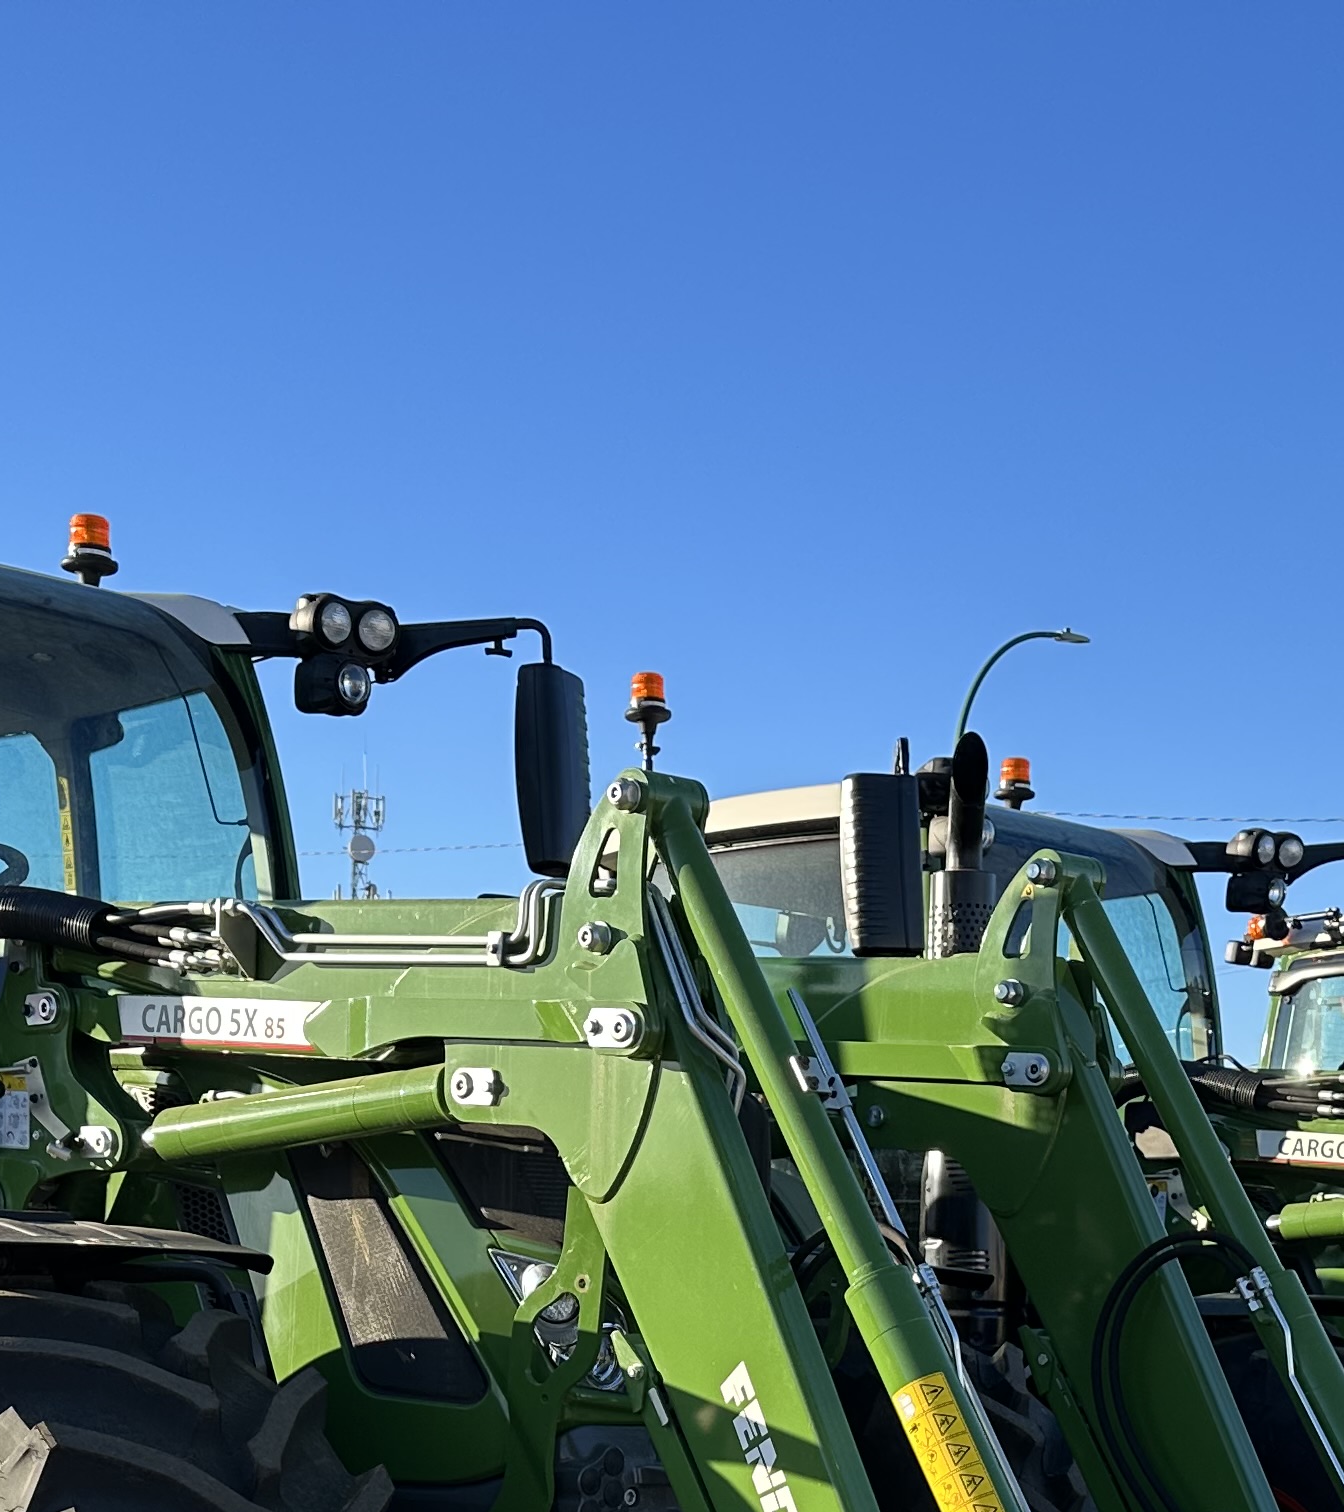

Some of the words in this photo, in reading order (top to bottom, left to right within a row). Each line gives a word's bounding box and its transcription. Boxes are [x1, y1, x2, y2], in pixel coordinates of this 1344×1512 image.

[142, 1003, 222, 1036] CARGO
[229, 1007, 259, 1037] 5X
[264, 1016, 286, 1039] 85
